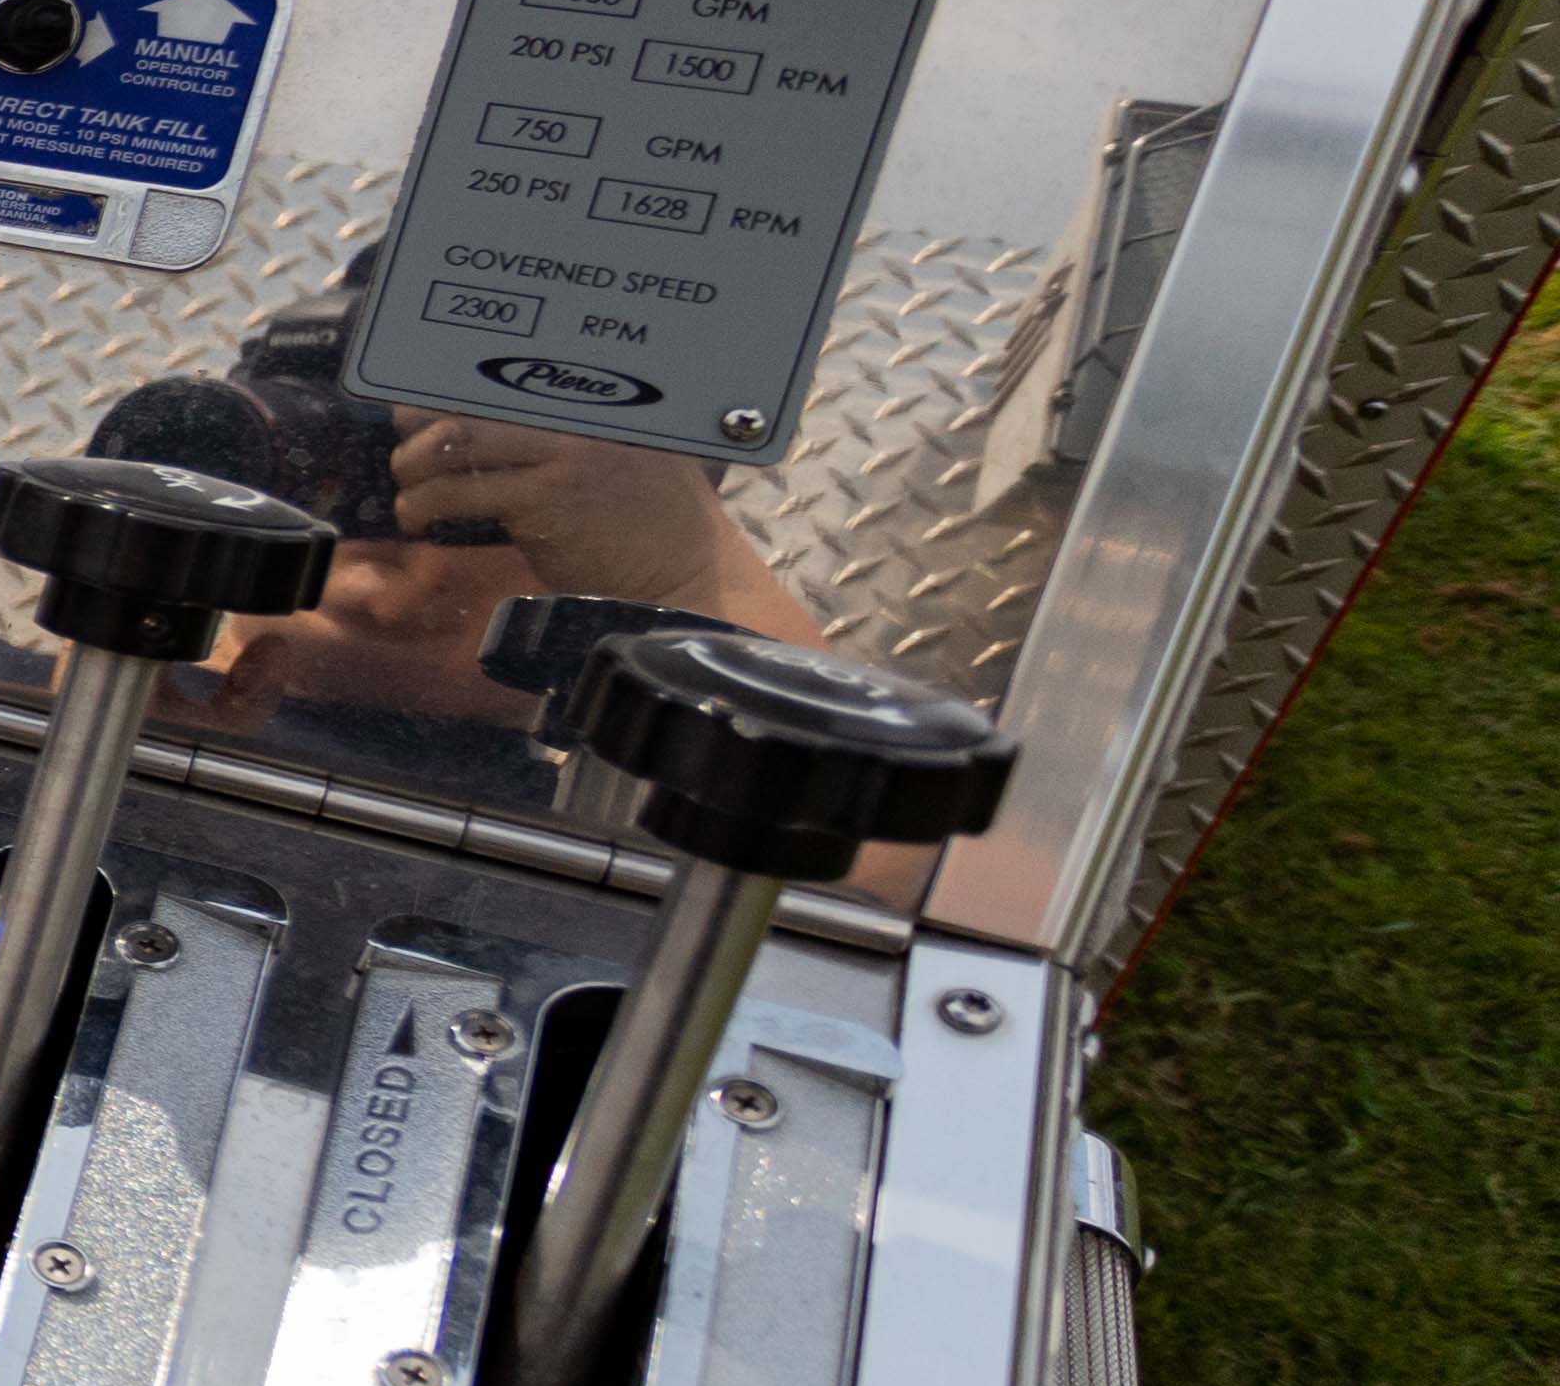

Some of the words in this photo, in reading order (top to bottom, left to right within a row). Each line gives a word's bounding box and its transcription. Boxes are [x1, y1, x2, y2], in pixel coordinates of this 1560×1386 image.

[134, 39, 240, 68] MANUAL
[136, 60, 227, 81] OPERATOR
[511, 34, 564, 63] 200
[571, 42, 614, 68] PSI
[664, 52, 735, 82] 1500
[776, 68, 848, 96] RPM
[120, 73, 235, 98] CONTROLLED
[6, 118, 59, 136] MODE
[76, 127, 94, 140] 10
[99, 130, 127, 146] PSI
[131, 134, 217, 159] MINIMUM
[80, 107, 147, 133] TANK
[154, 117, 208, 141] FILL
[513, 118, 566, 144] 750
[647, 136, 722, 166] GPM
[14, 135, 105, 160] PRESSURE
[113, 149, 202, 173] REQUIRED
[467, 169, 520, 198] 250
[527, 177, 570, 203] PSI
[621, 192, 687, 221] 1628
[729, 208, 800, 236] RPM
[444, 245, 616, 290] GOVERNED
[624, 273, 717, 304] SPEED
[449, 294, 518, 324] 2300
[579, 315, 647, 344] RPM
[521, 361, 616, 399] Pierce
